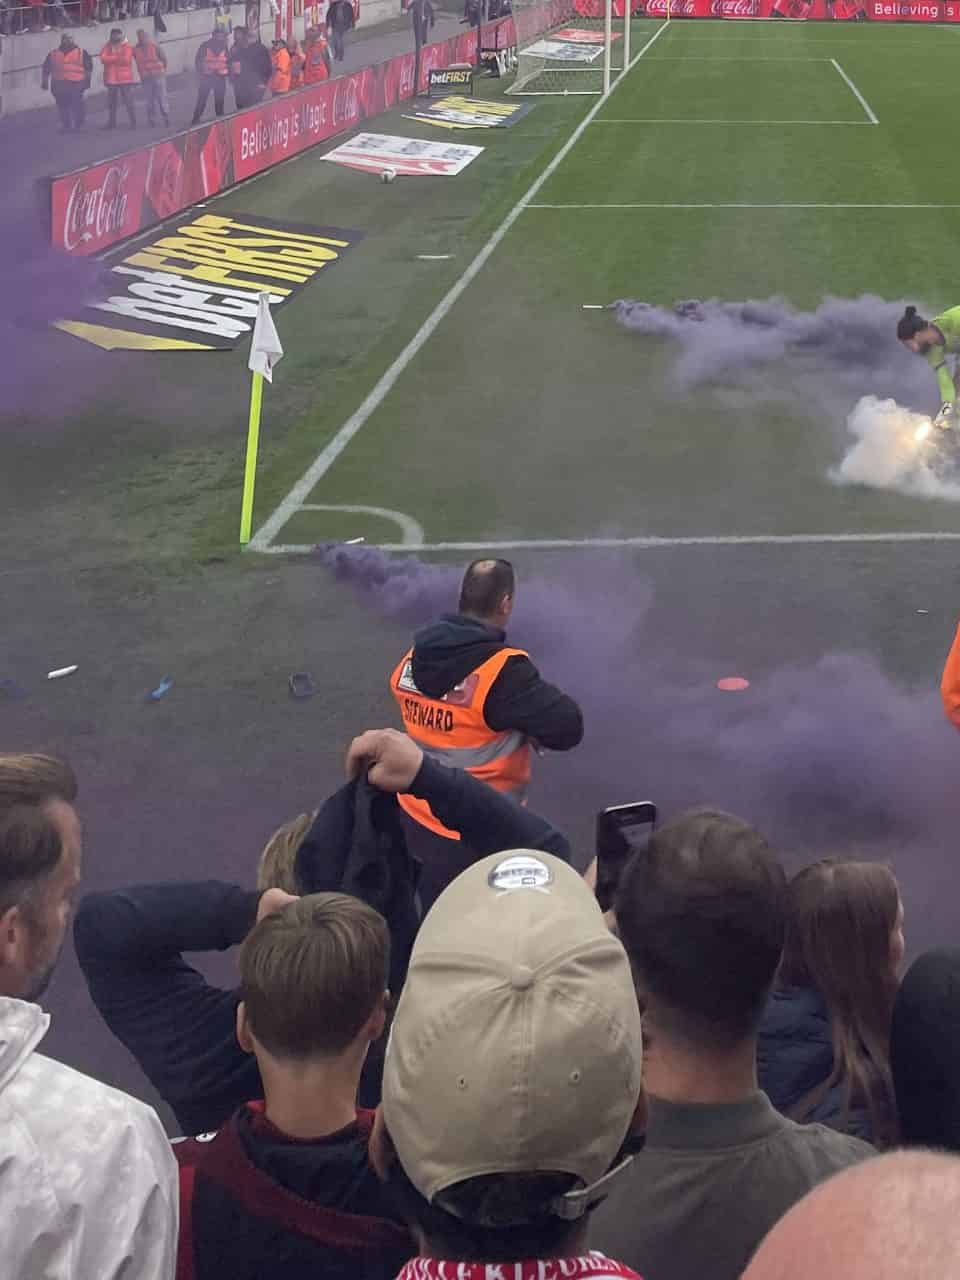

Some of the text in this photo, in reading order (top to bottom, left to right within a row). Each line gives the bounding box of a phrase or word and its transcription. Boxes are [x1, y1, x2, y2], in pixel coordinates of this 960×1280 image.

[874, 3, 938, 18] Believing
[431, 71, 472, 84] betFIRST
[240, 113, 289, 160] Believing
[404, 698, 453, 732] STEWARD
